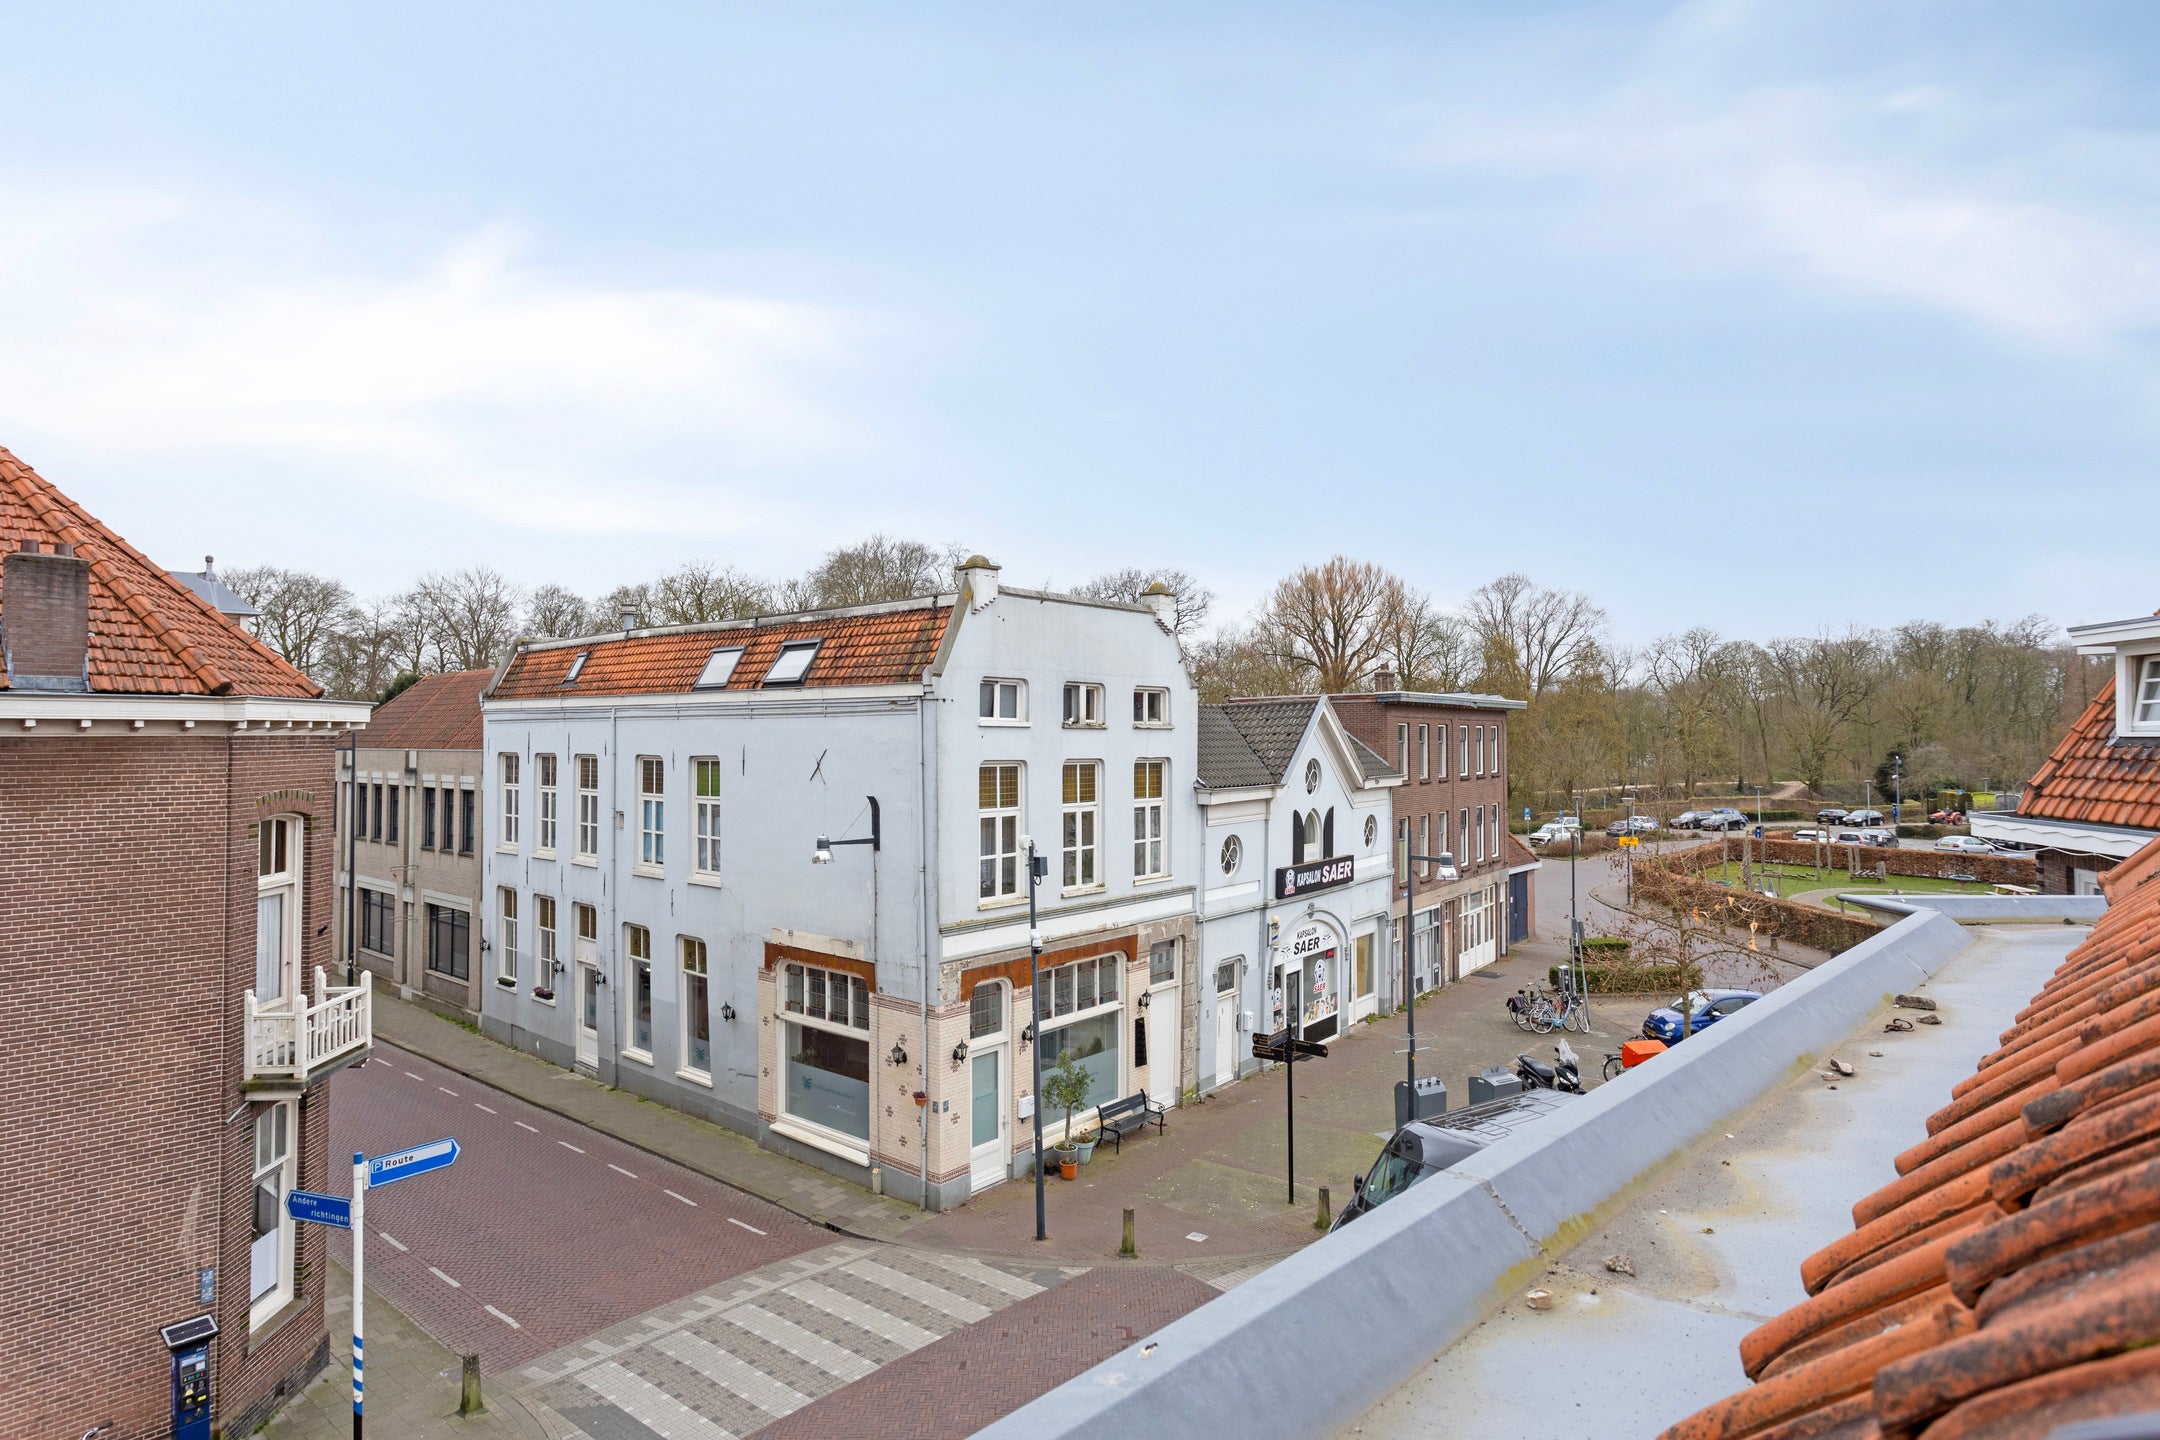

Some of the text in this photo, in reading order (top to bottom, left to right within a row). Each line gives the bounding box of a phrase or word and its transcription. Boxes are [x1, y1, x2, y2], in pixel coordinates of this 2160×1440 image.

[1297, 861, 1352, 887] KAPSALON SAER
[1297, 927, 1317, 939] KAPSALON
[1293, 936, 1320, 955] SAER
[1313, 982, 1326, 994] SAER
[385, 1154, 413, 1168] Route
[292, 1195, 318, 1206] Andere
[310, 1209, 349, 1223] richtingen
